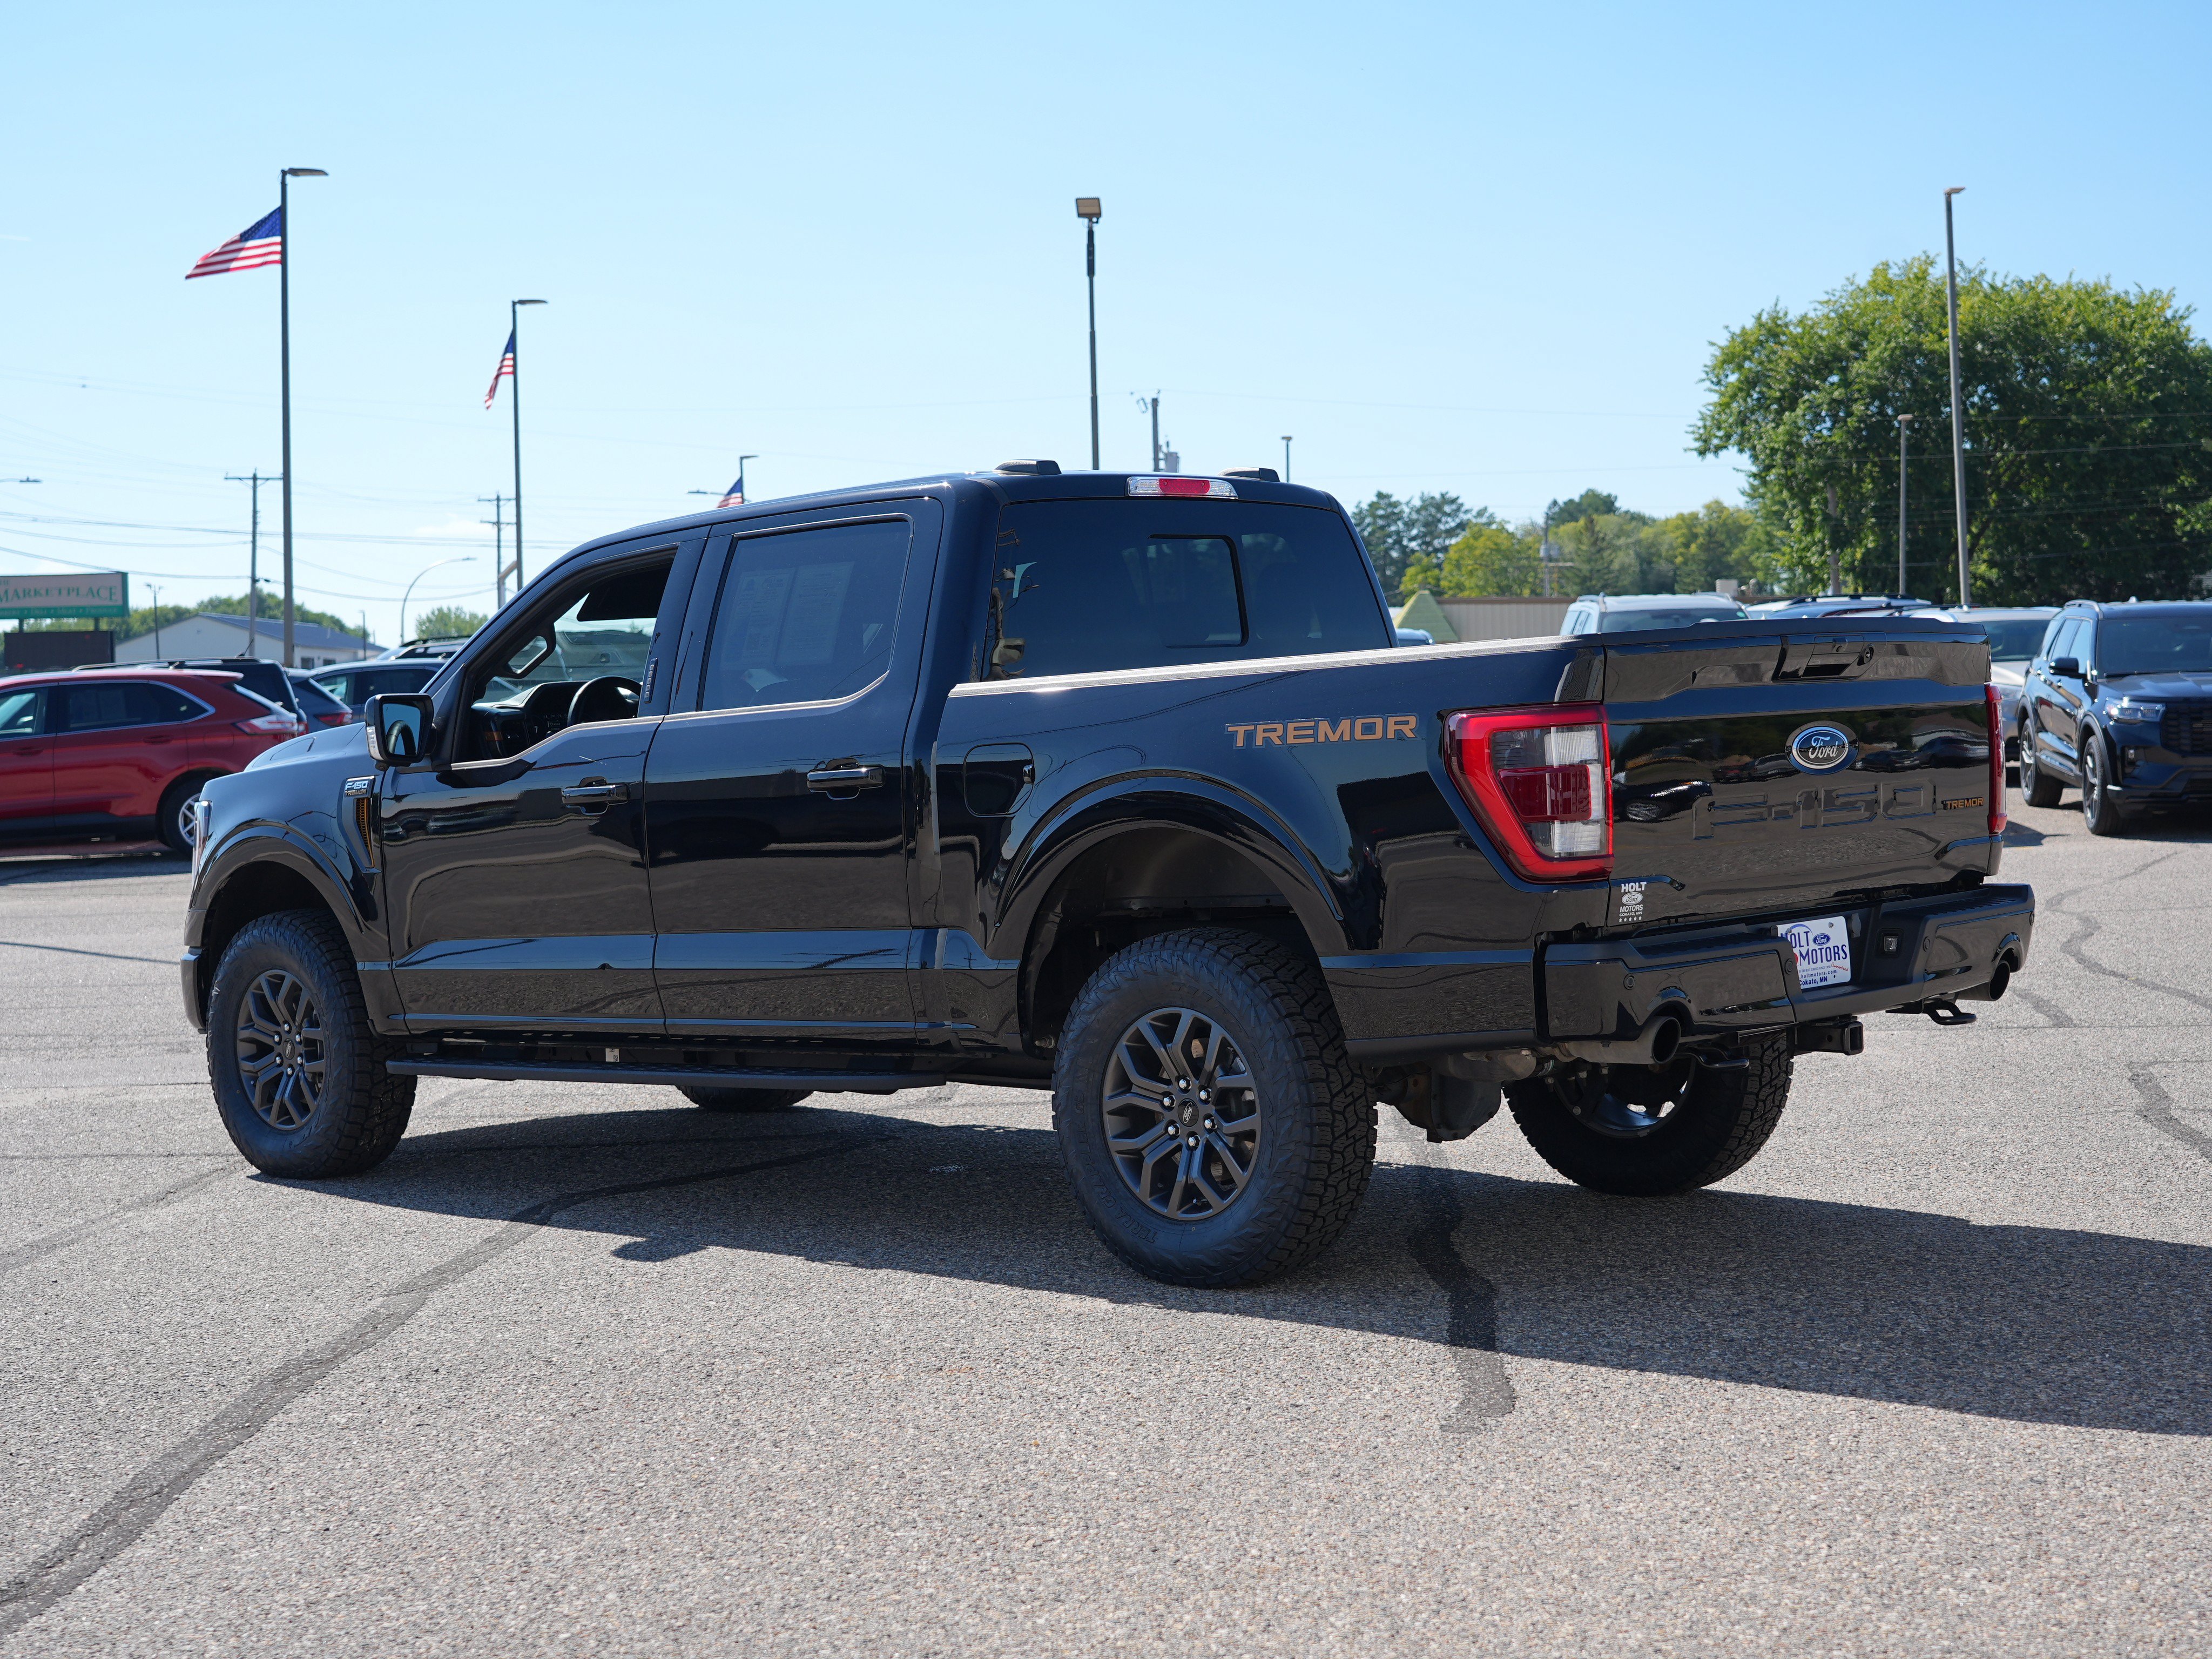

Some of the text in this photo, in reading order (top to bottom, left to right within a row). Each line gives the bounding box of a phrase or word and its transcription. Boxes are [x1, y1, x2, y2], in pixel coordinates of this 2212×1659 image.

[1227, 715, 1417, 747] TREMOR
[1809, 735, 1838, 759] Ford
[346, 780, 368, 790] F-150
[1692, 778, 1936, 840] F-150
[1945, 797, 1984, 810] TREMOR
[1621, 881, 1647, 893] HOLT
[1620, 904, 1643, 913] MOTORS
[1799, 944, 1847, 967] MOTORS
